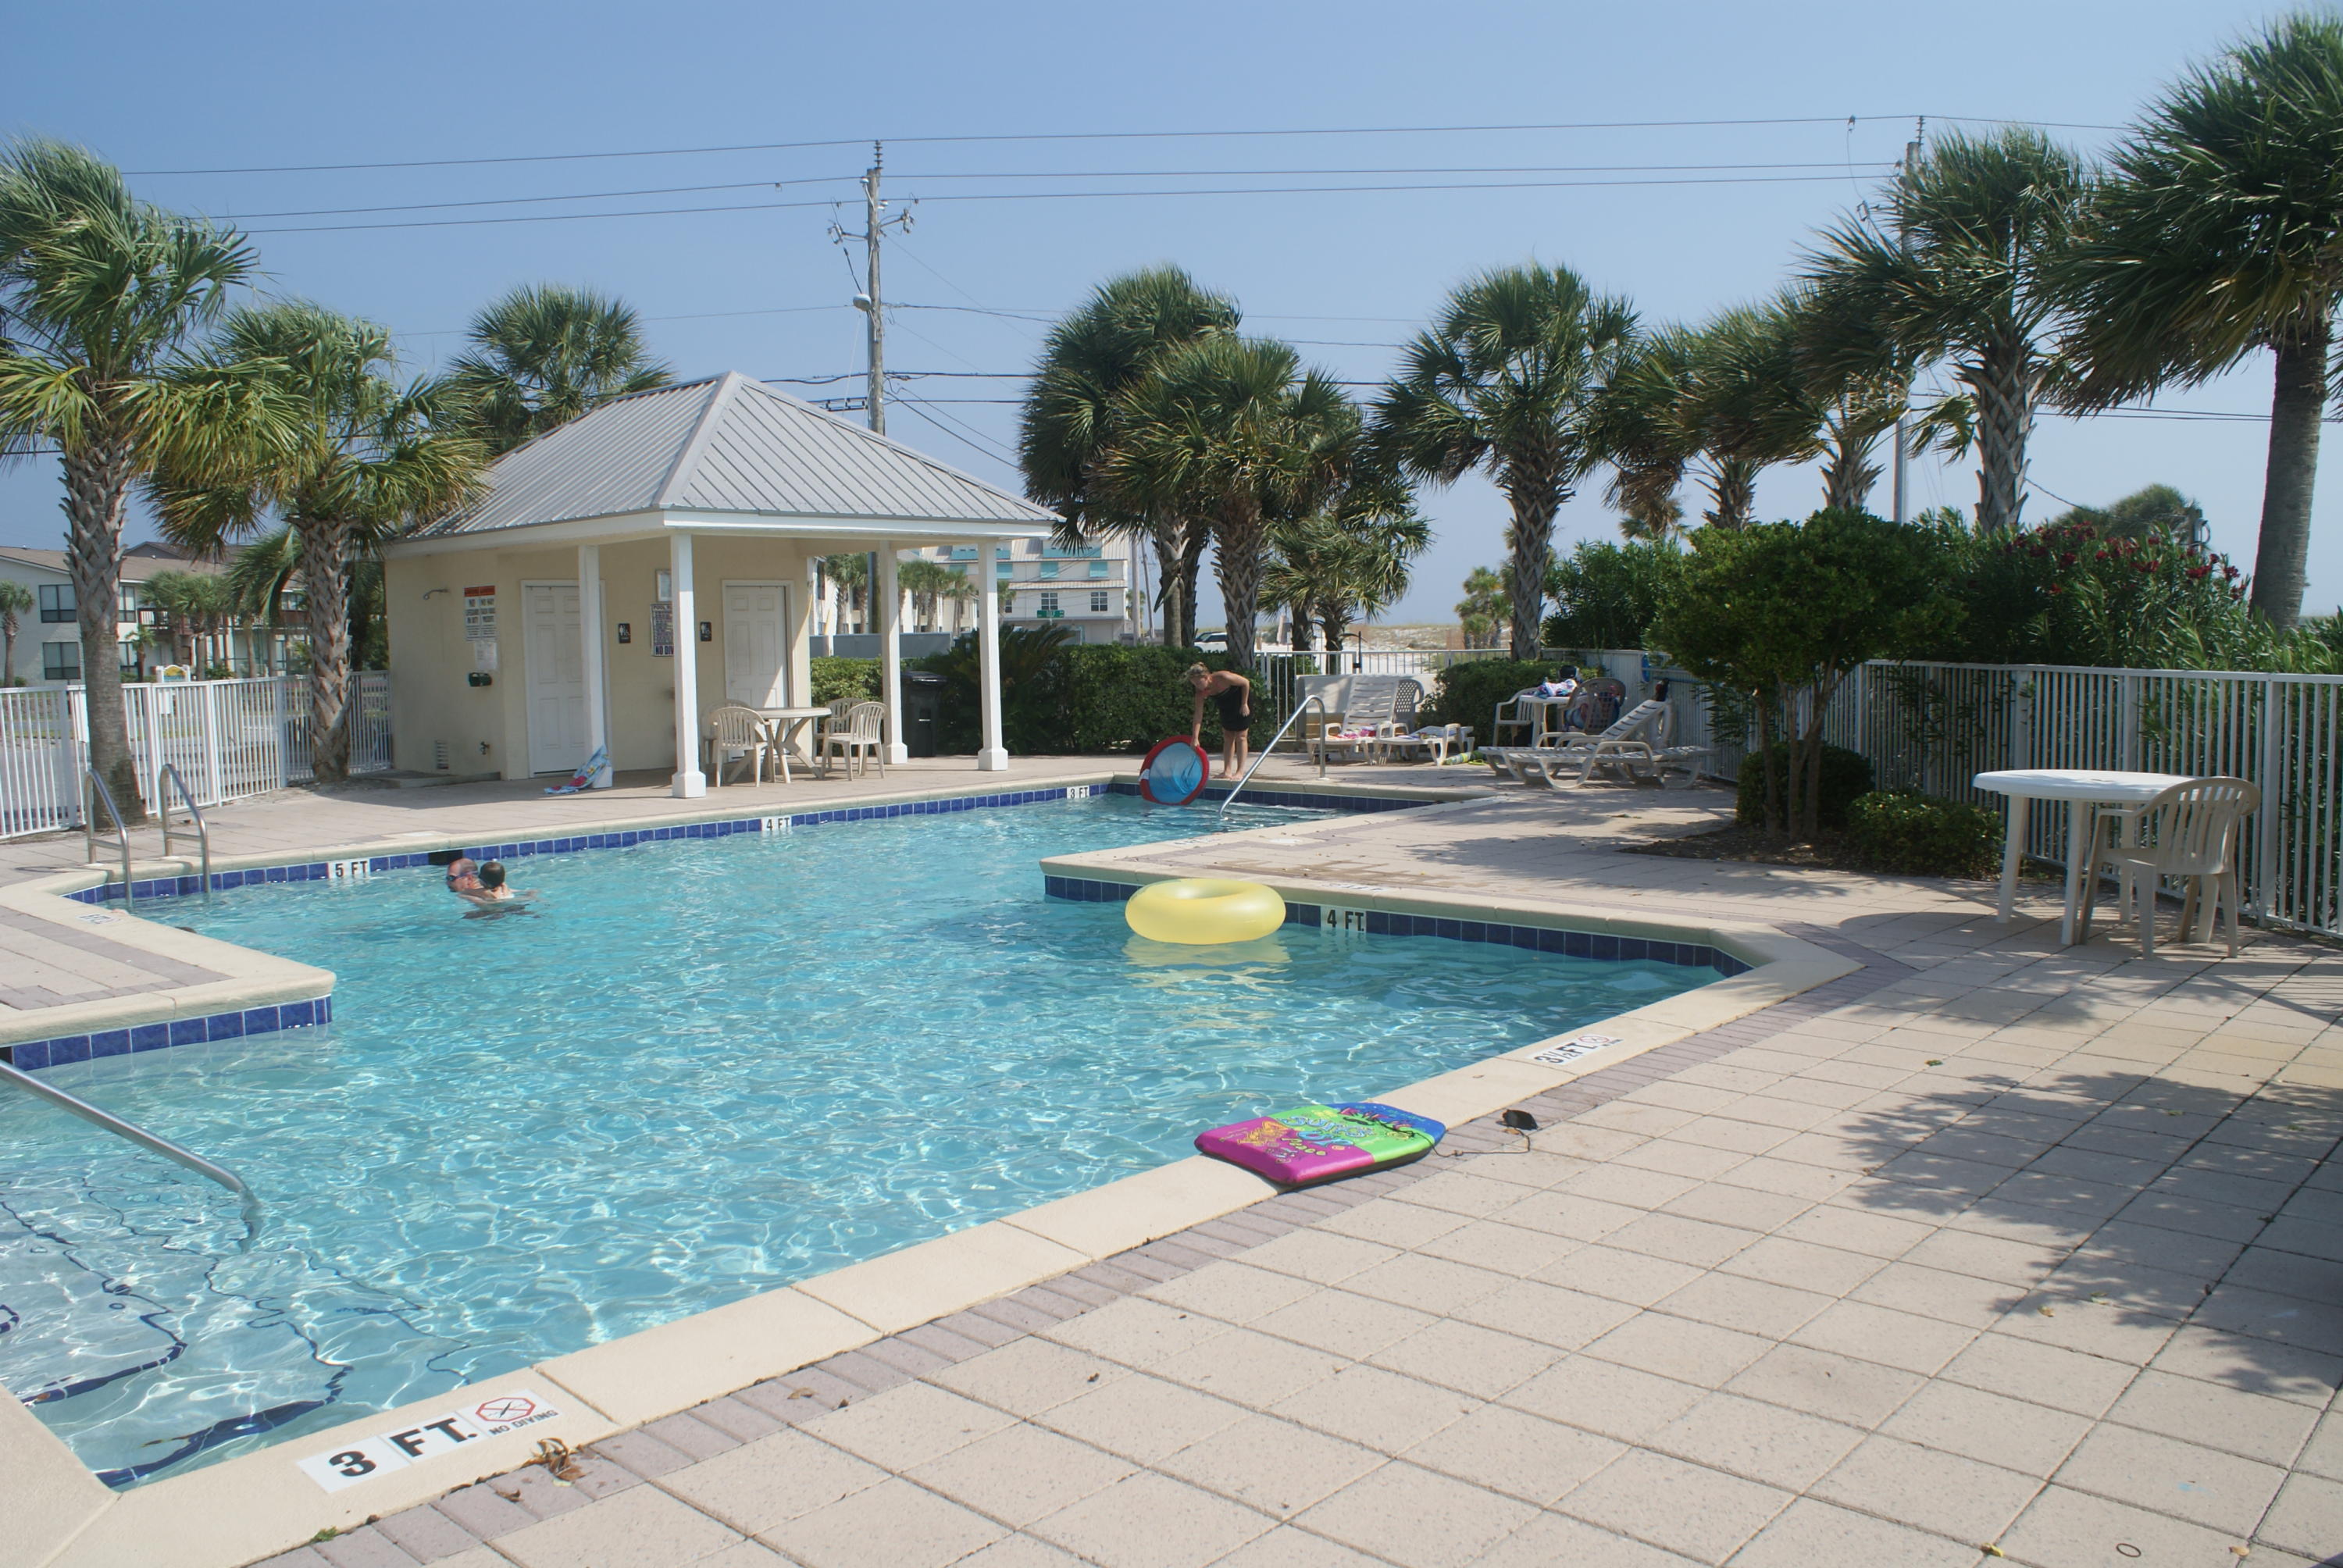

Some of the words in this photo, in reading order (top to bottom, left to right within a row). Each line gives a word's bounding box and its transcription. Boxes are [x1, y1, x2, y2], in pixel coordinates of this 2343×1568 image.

[766, 818, 773, 831] 4
[335, 863, 344, 877] 5
[1327, 909, 1337, 928] 4
[489, 1424, 511, 1435] NO
[512, 1409, 559, 1428] DIVING
[328, 1450, 376, 1477] 3
[390, 1417, 478, 1458] FT.
